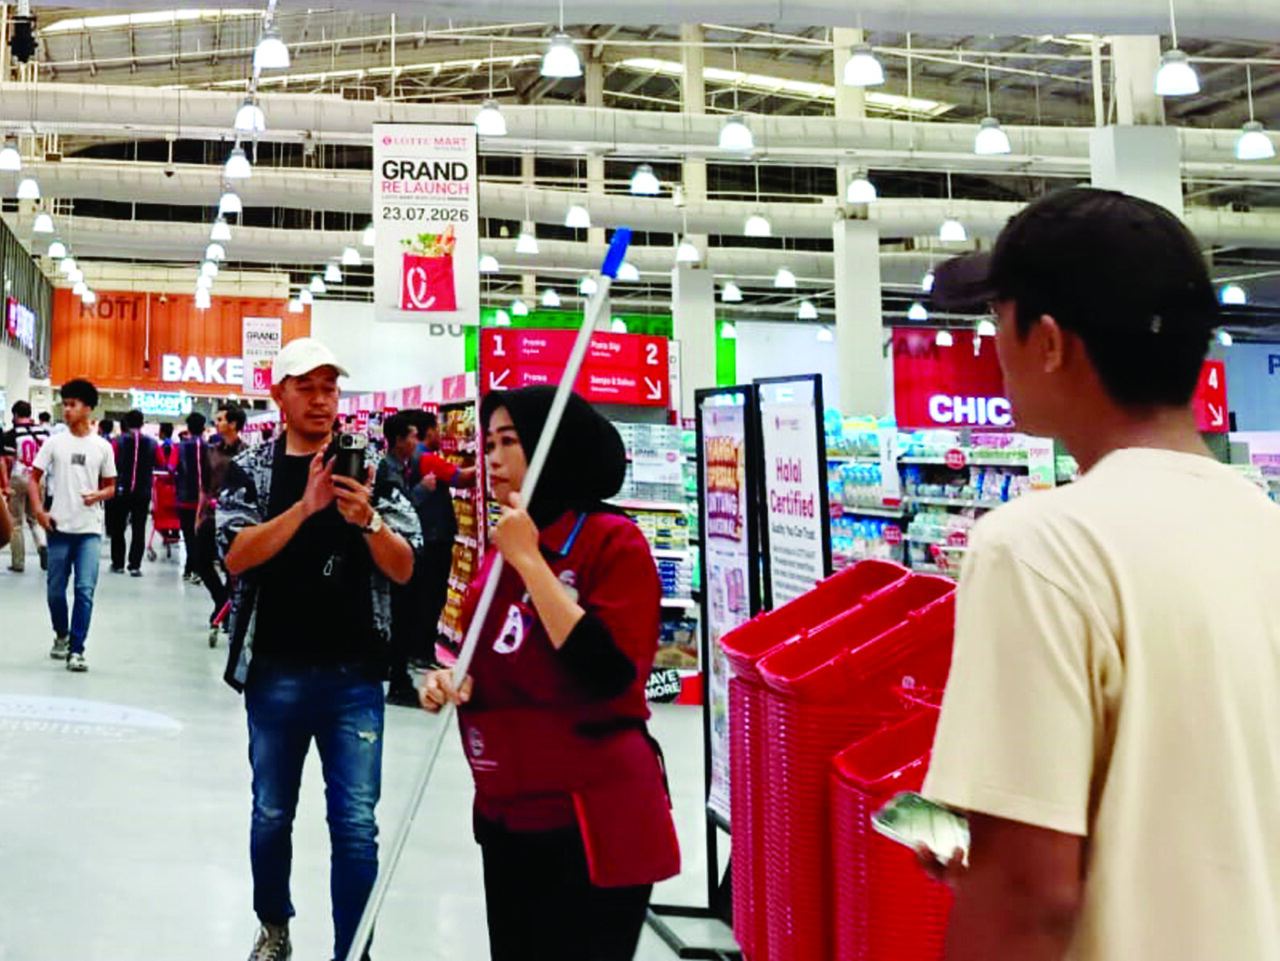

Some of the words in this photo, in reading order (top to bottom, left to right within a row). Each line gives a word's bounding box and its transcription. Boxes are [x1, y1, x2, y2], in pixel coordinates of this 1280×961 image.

[382, 160, 469, 182] GRAND
[404, 182, 470, 196] LAUNCH
[382, 206, 470, 223] 23.07.2026
[78, 295, 140, 321] ROTI
[493, 335, 506, 356] 1
[646, 343, 659, 365] 2
[162, 354, 244, 385] BAKE
[1208, 368, 1218, 390] 4
[133, 392, 192, 415] Bakery
[929, 394, 1012, 425] CHIC
[776, 457, 802, 483] Halal
[770, 490, 814, 518] Certified
